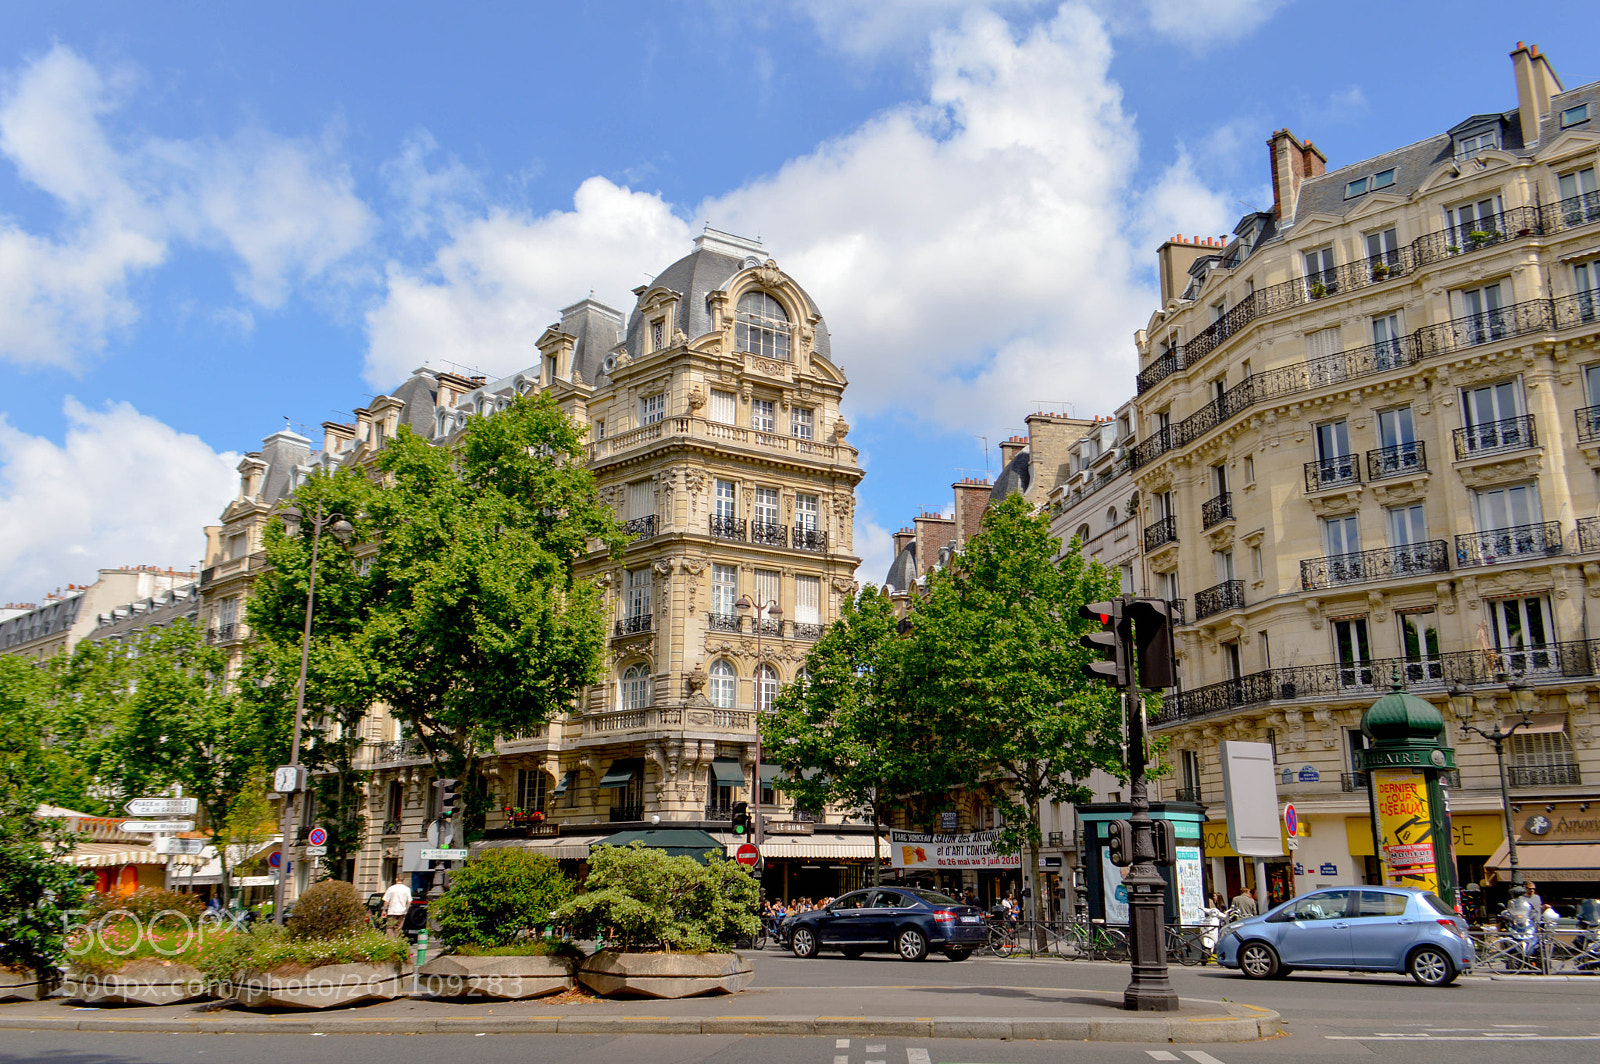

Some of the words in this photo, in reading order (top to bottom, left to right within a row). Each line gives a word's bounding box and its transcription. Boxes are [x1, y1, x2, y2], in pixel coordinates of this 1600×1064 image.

[1379, 783, 1417, 794] DERNIER
[1386, 793, 1411, 805] COUP
[1379, 802, 1420, 816] CISEAUX
[776, 823, 784, 831] LE
[894, 832, 907, 842] PARC
[935, 834, 957, 843] SALON
[957, 835, 971, 843] des
[938, 858, 946, 866] du
[947, 858, 957, 866] 26
[958, 858, 971, 866] mai
[987, 856, 1000, 866] juin
[1001, 856, 1019, 865] 2018
